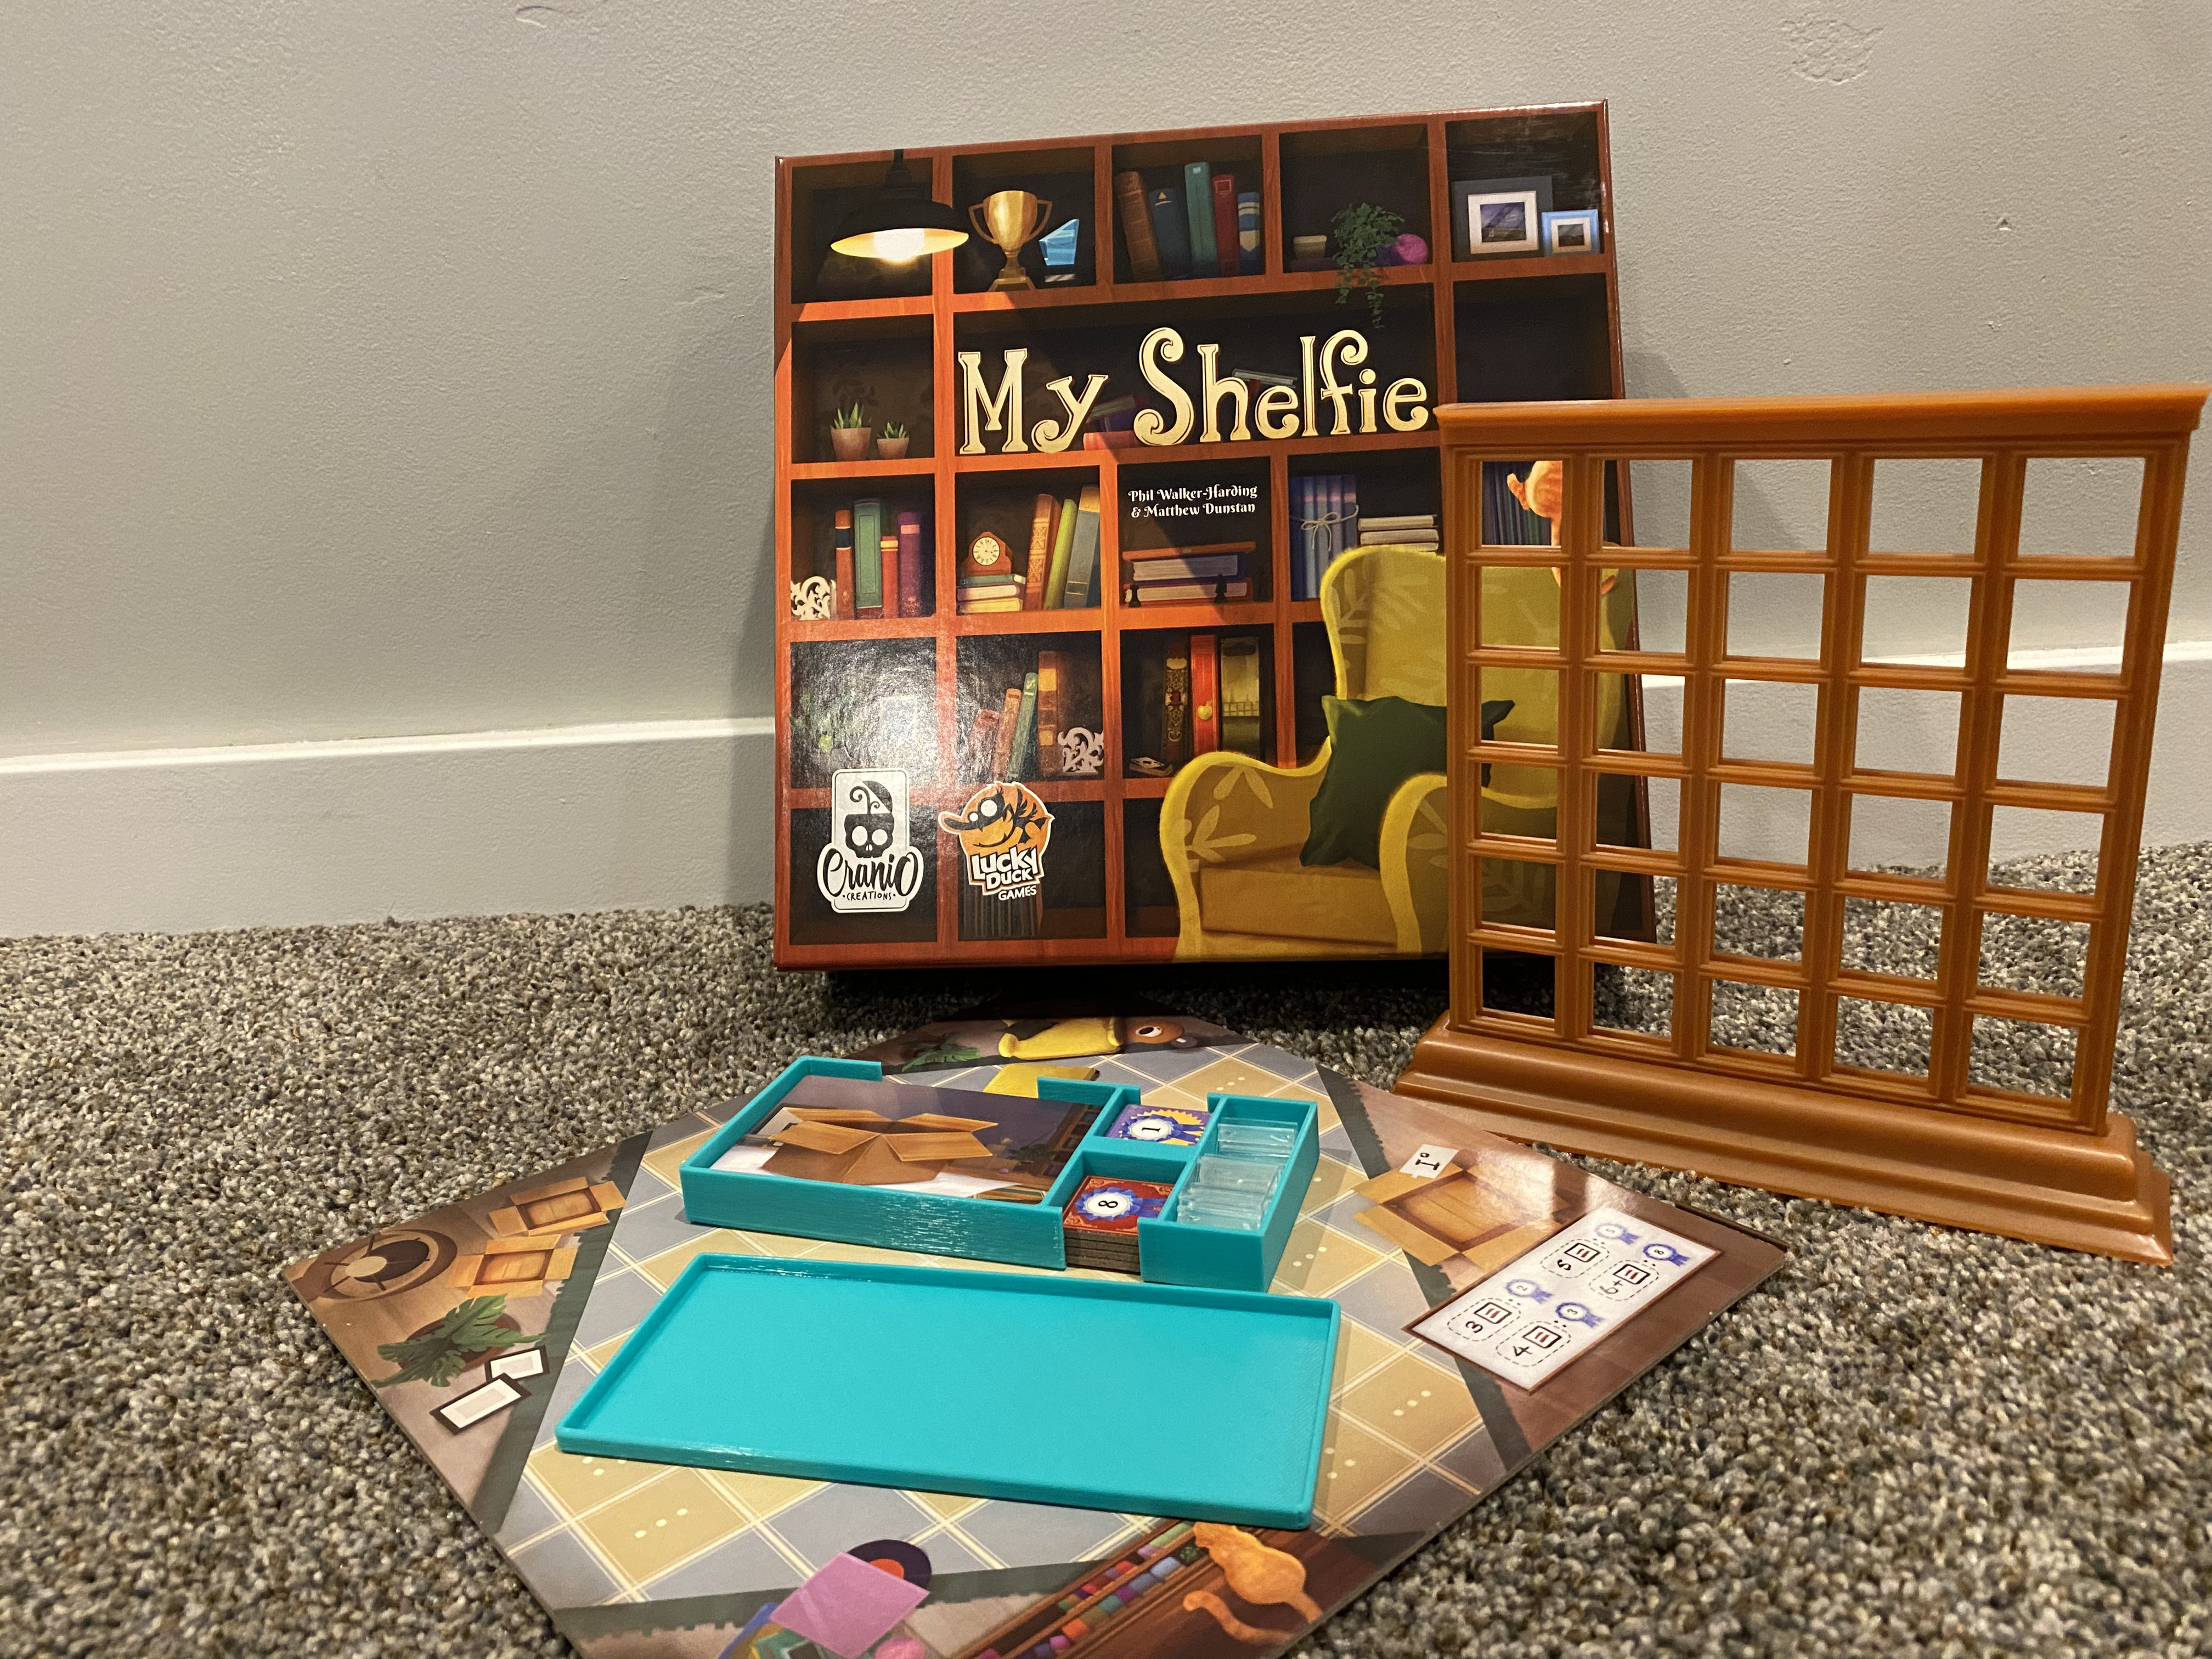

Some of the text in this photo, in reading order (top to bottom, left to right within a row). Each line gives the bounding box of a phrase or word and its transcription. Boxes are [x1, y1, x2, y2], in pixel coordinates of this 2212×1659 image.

[957, 327, 1429, 455] My Shelfie
[1128, 484, 1258, 502] Phil Walker-Harding
[1131, 503, 1255, 518] & Matthew Dunstan
[998, 885, 1037, 901] GAMES
[1098, 1200, 1118, 1209] 8
[1465, 1321, 1483, 1334] 3
[1513, 1344, 1533, 1357] 4
